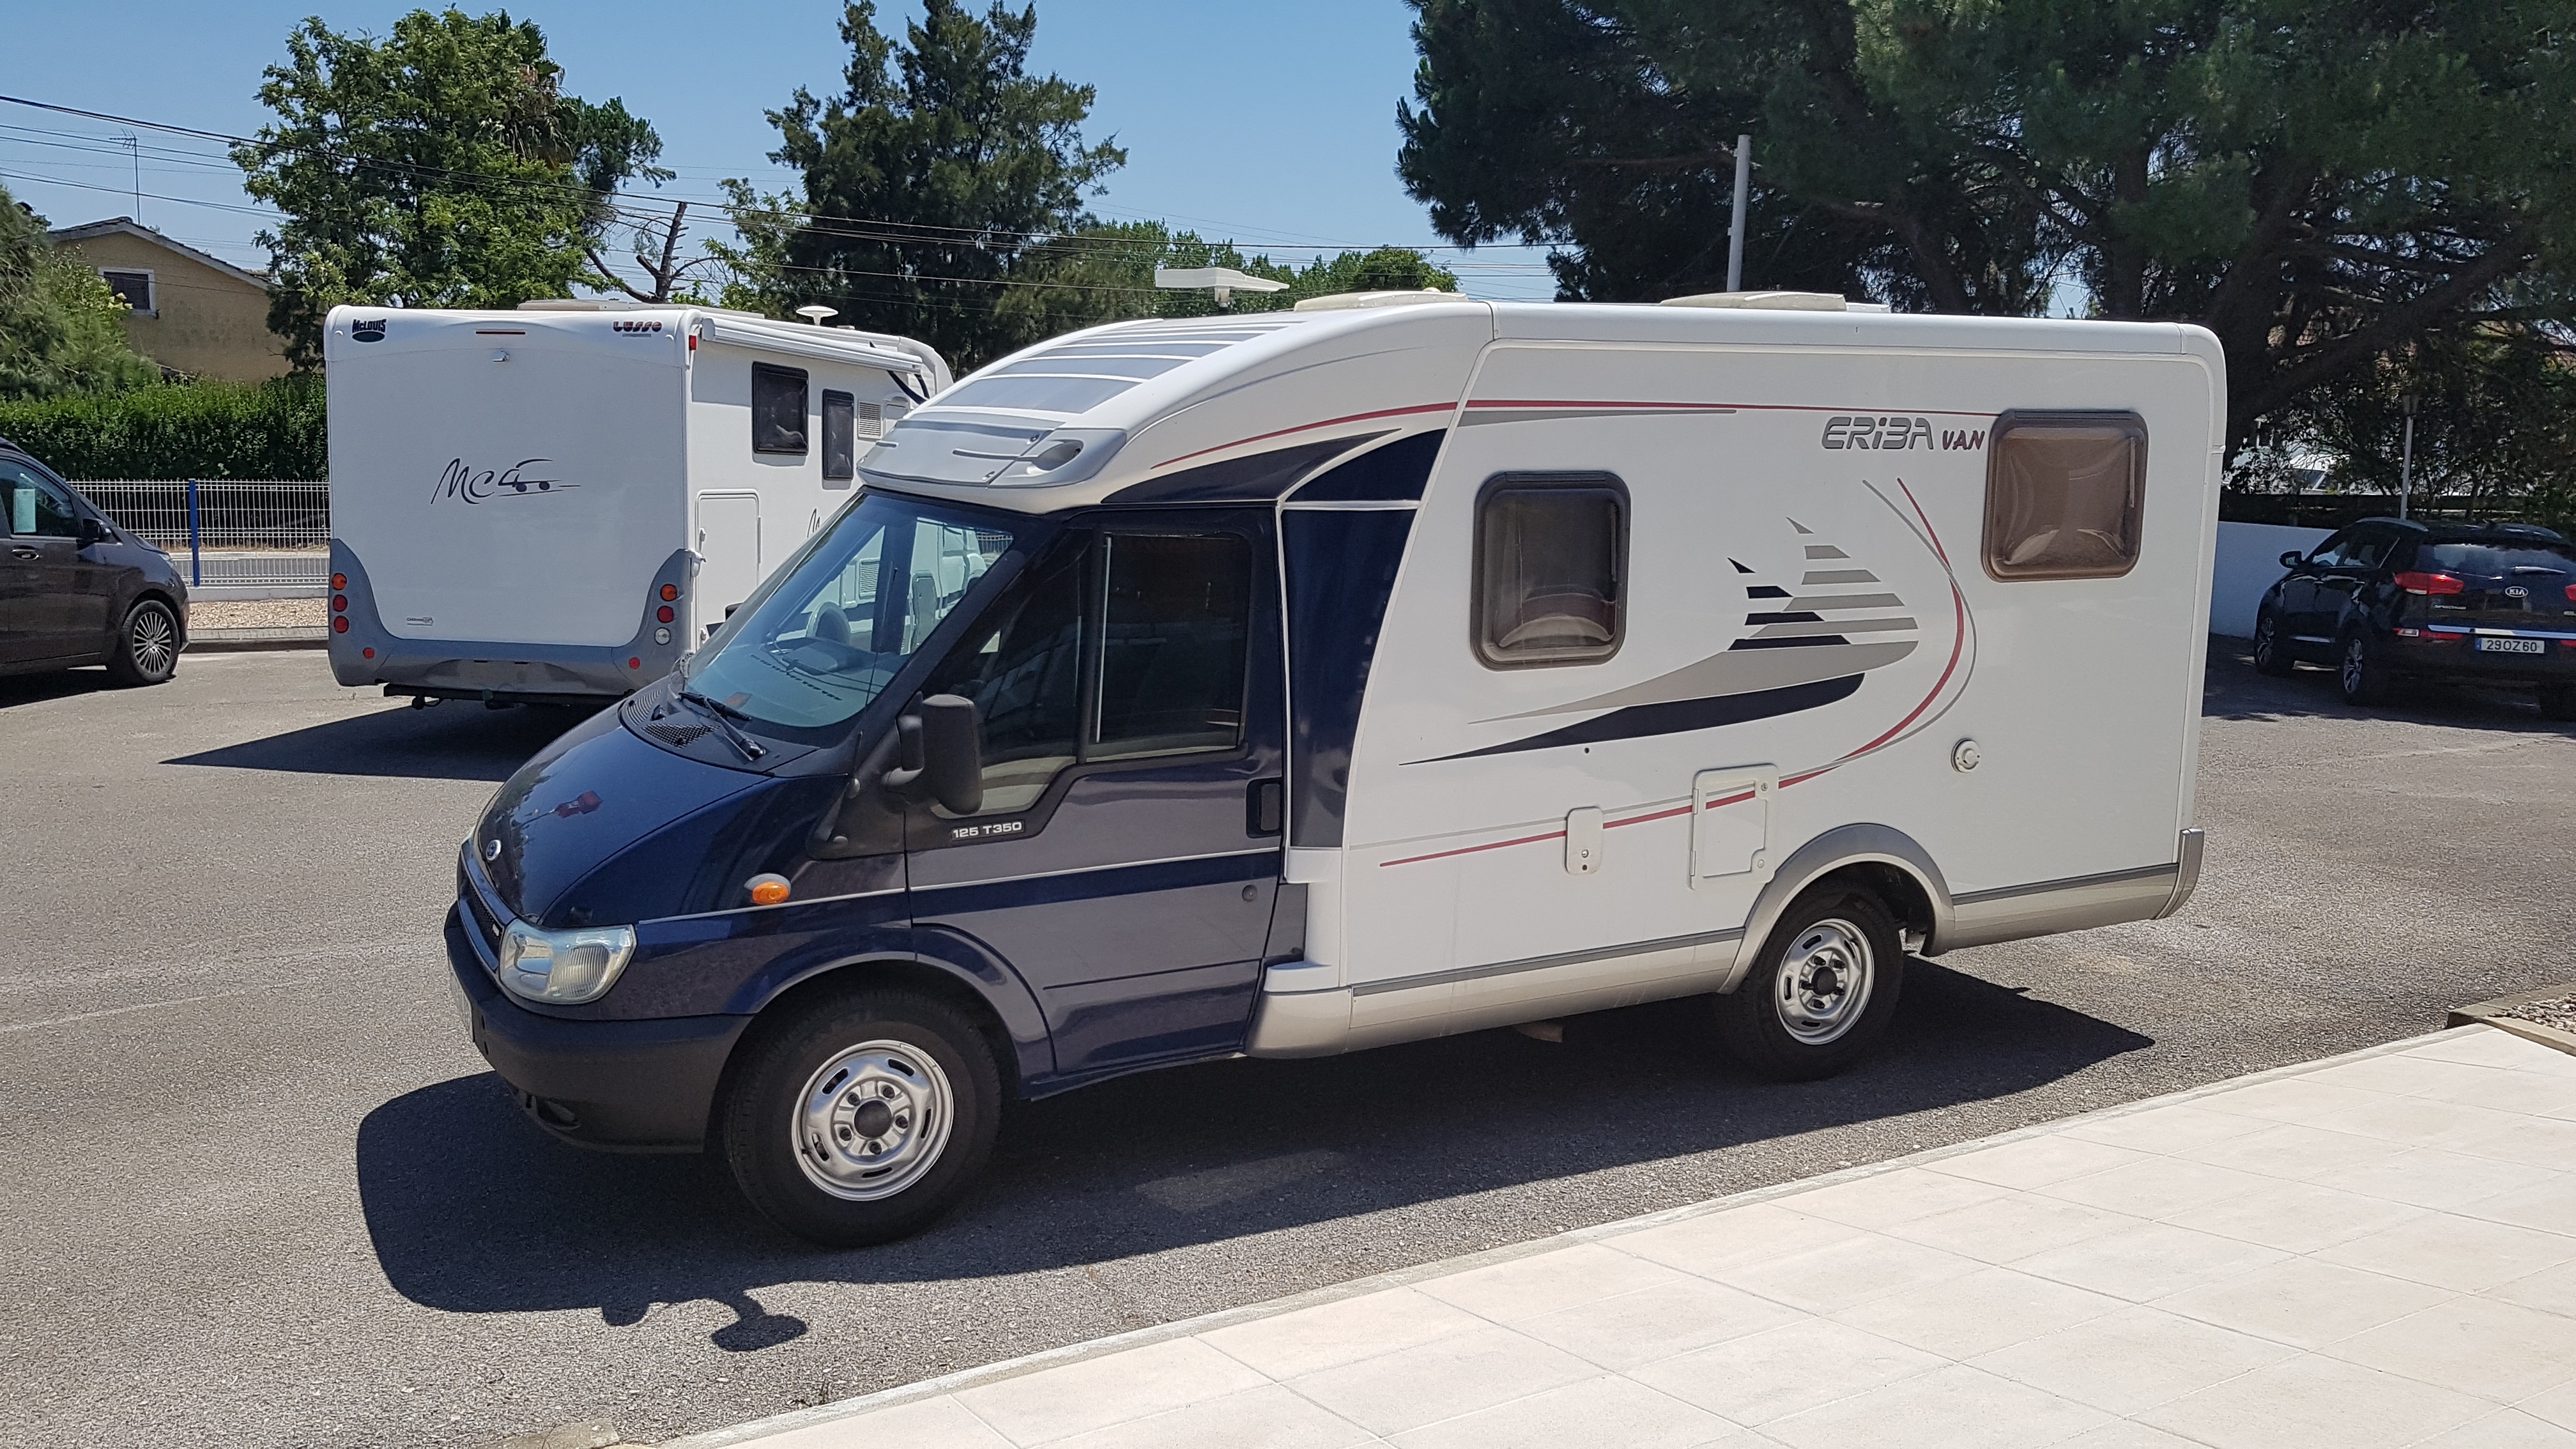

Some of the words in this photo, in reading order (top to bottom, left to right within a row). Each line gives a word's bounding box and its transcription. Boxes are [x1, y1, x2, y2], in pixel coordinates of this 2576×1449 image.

[613, 321, 662, 332] LUSSO
[1942, 430, 1986, 450] VAN
[953, 827, 979, 838] 125
[983, 822, 1022, 834] T350
